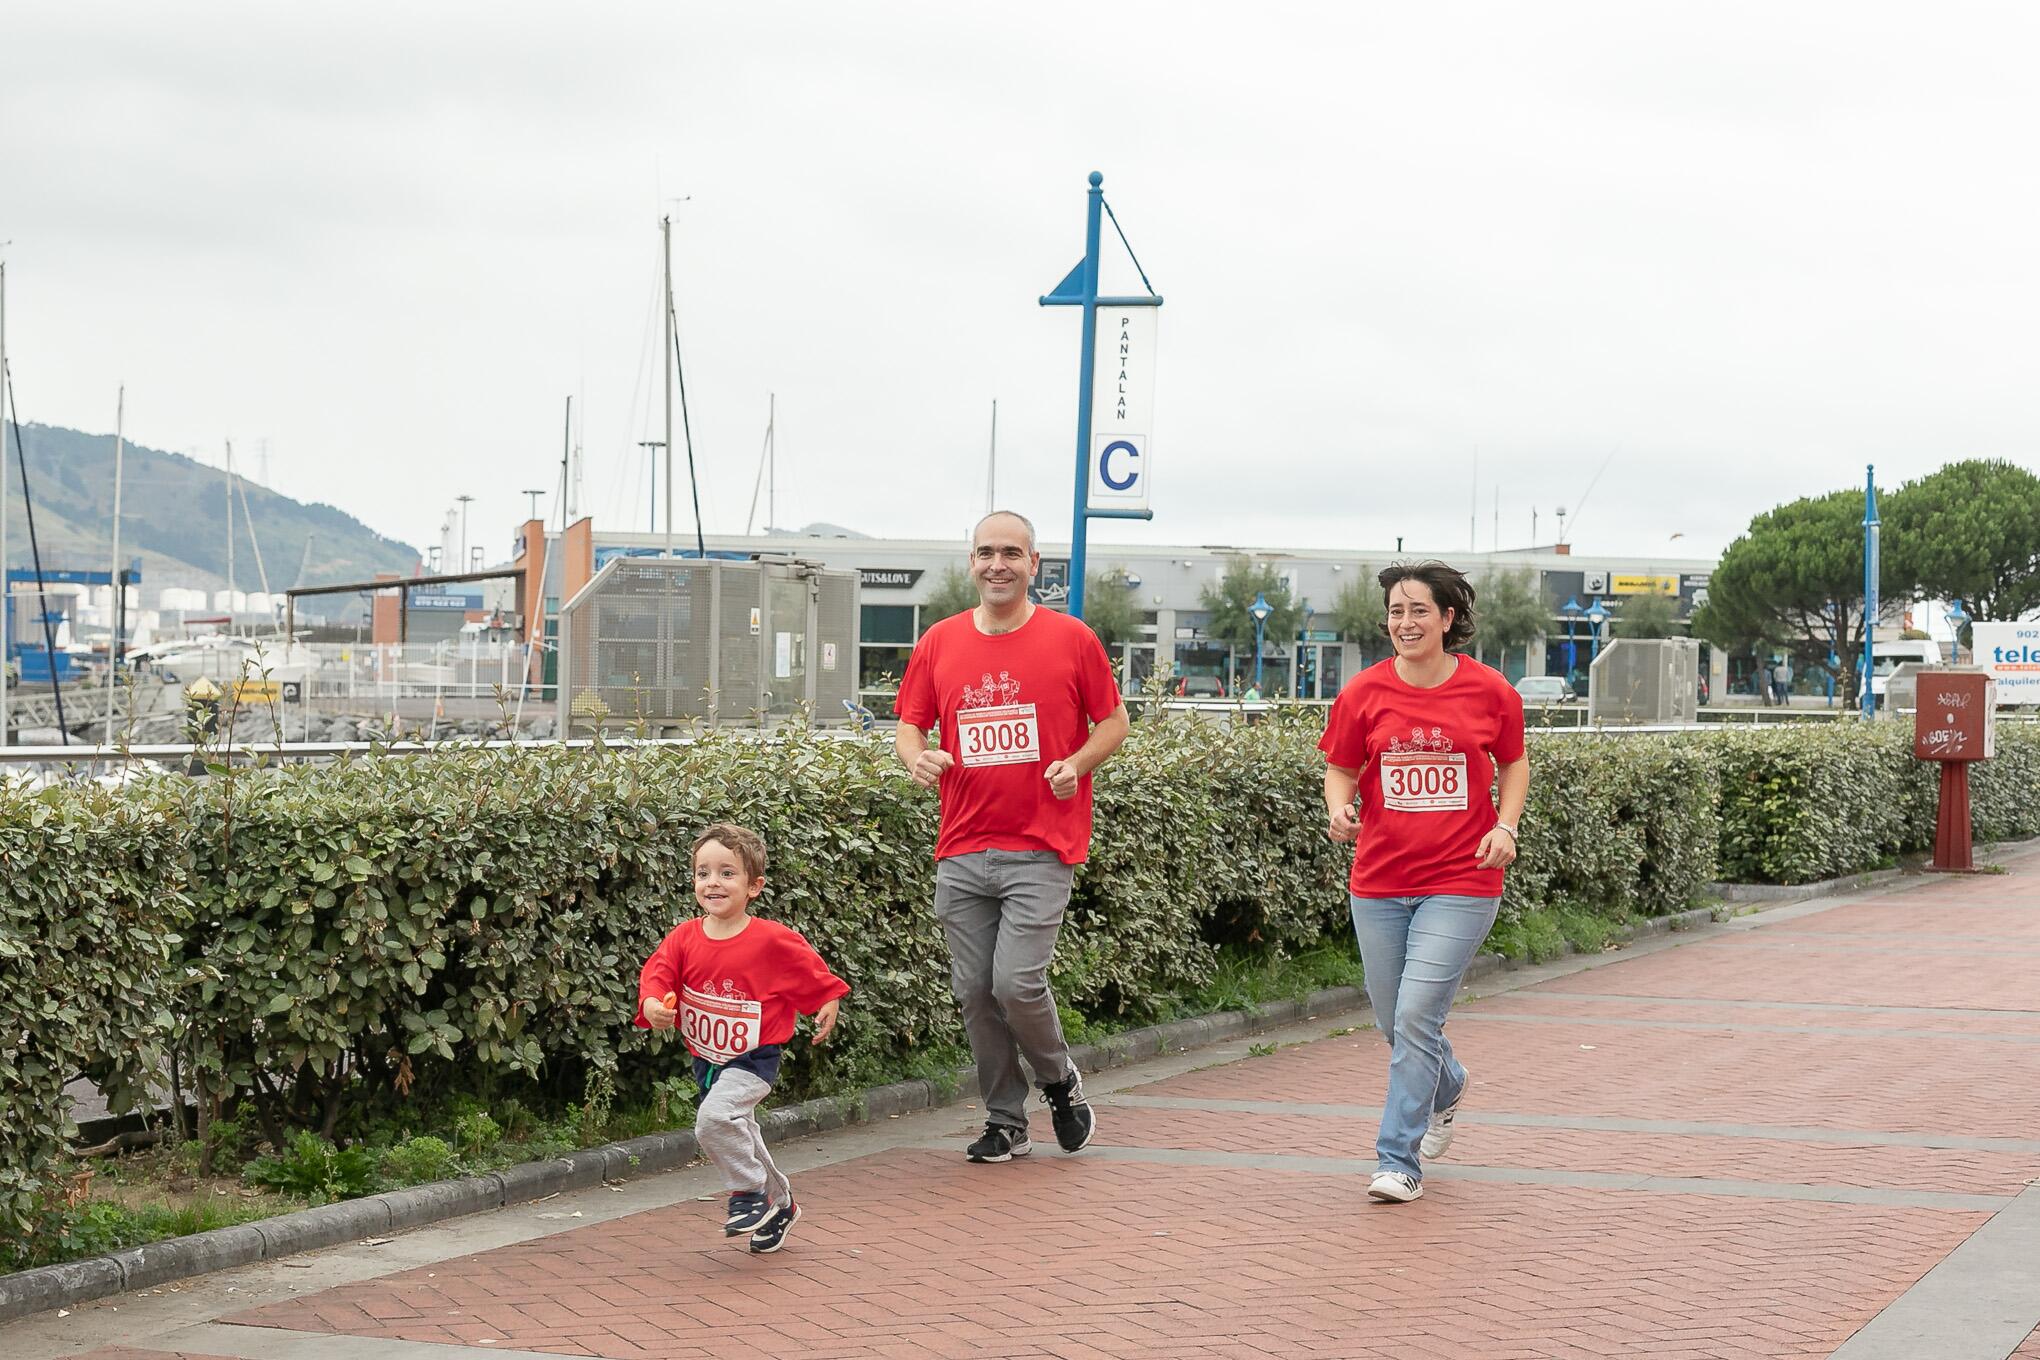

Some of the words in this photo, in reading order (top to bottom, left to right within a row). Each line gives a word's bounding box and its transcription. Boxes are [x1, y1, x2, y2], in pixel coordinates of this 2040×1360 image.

[1117, 317, 1129, 419] PANTALAN
[1100, 440, 1139, 491] C
[968, 722, 1030, 754] 3008
[1390, 767, 1459, 796] 3008
[685, 1008, 749, 1054] 3008
